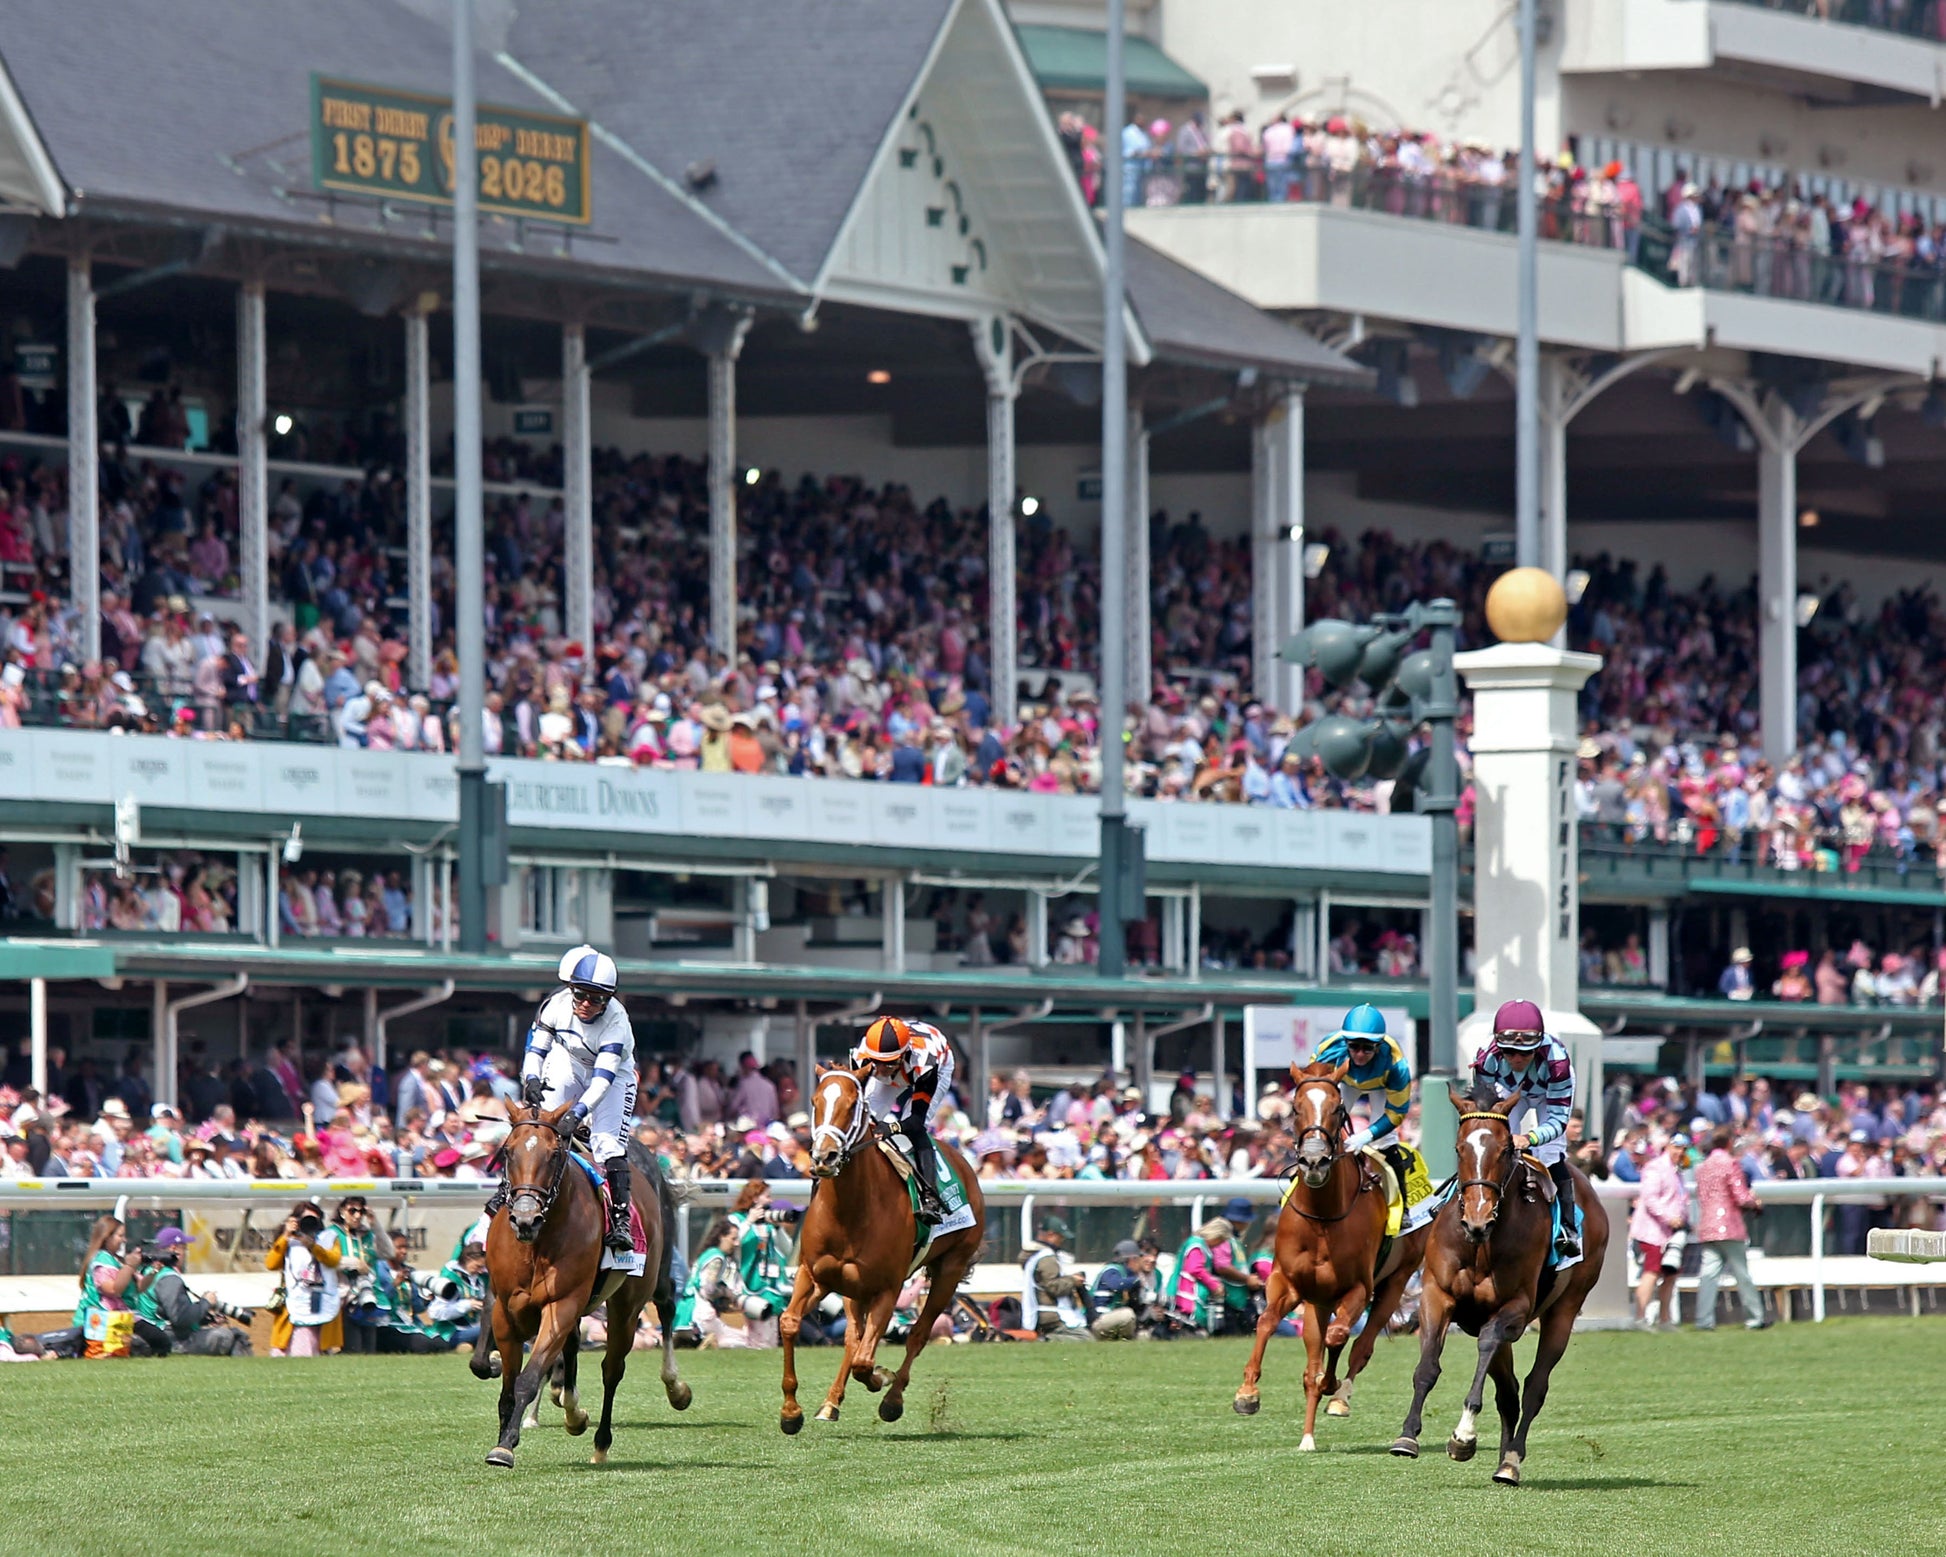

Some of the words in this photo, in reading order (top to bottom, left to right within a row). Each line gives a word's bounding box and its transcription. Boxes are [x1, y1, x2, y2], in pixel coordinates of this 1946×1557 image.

[322, 97, 371, 132] FIRST
[333, 133, 421, 184] 1875
[481, 156, 566, 207] 2026
[1558, 761, 1570, 939] FINISH
[623, 1082, 637, 1118] RUBY'S
[618, 1118, 631, 1144] JEFF
